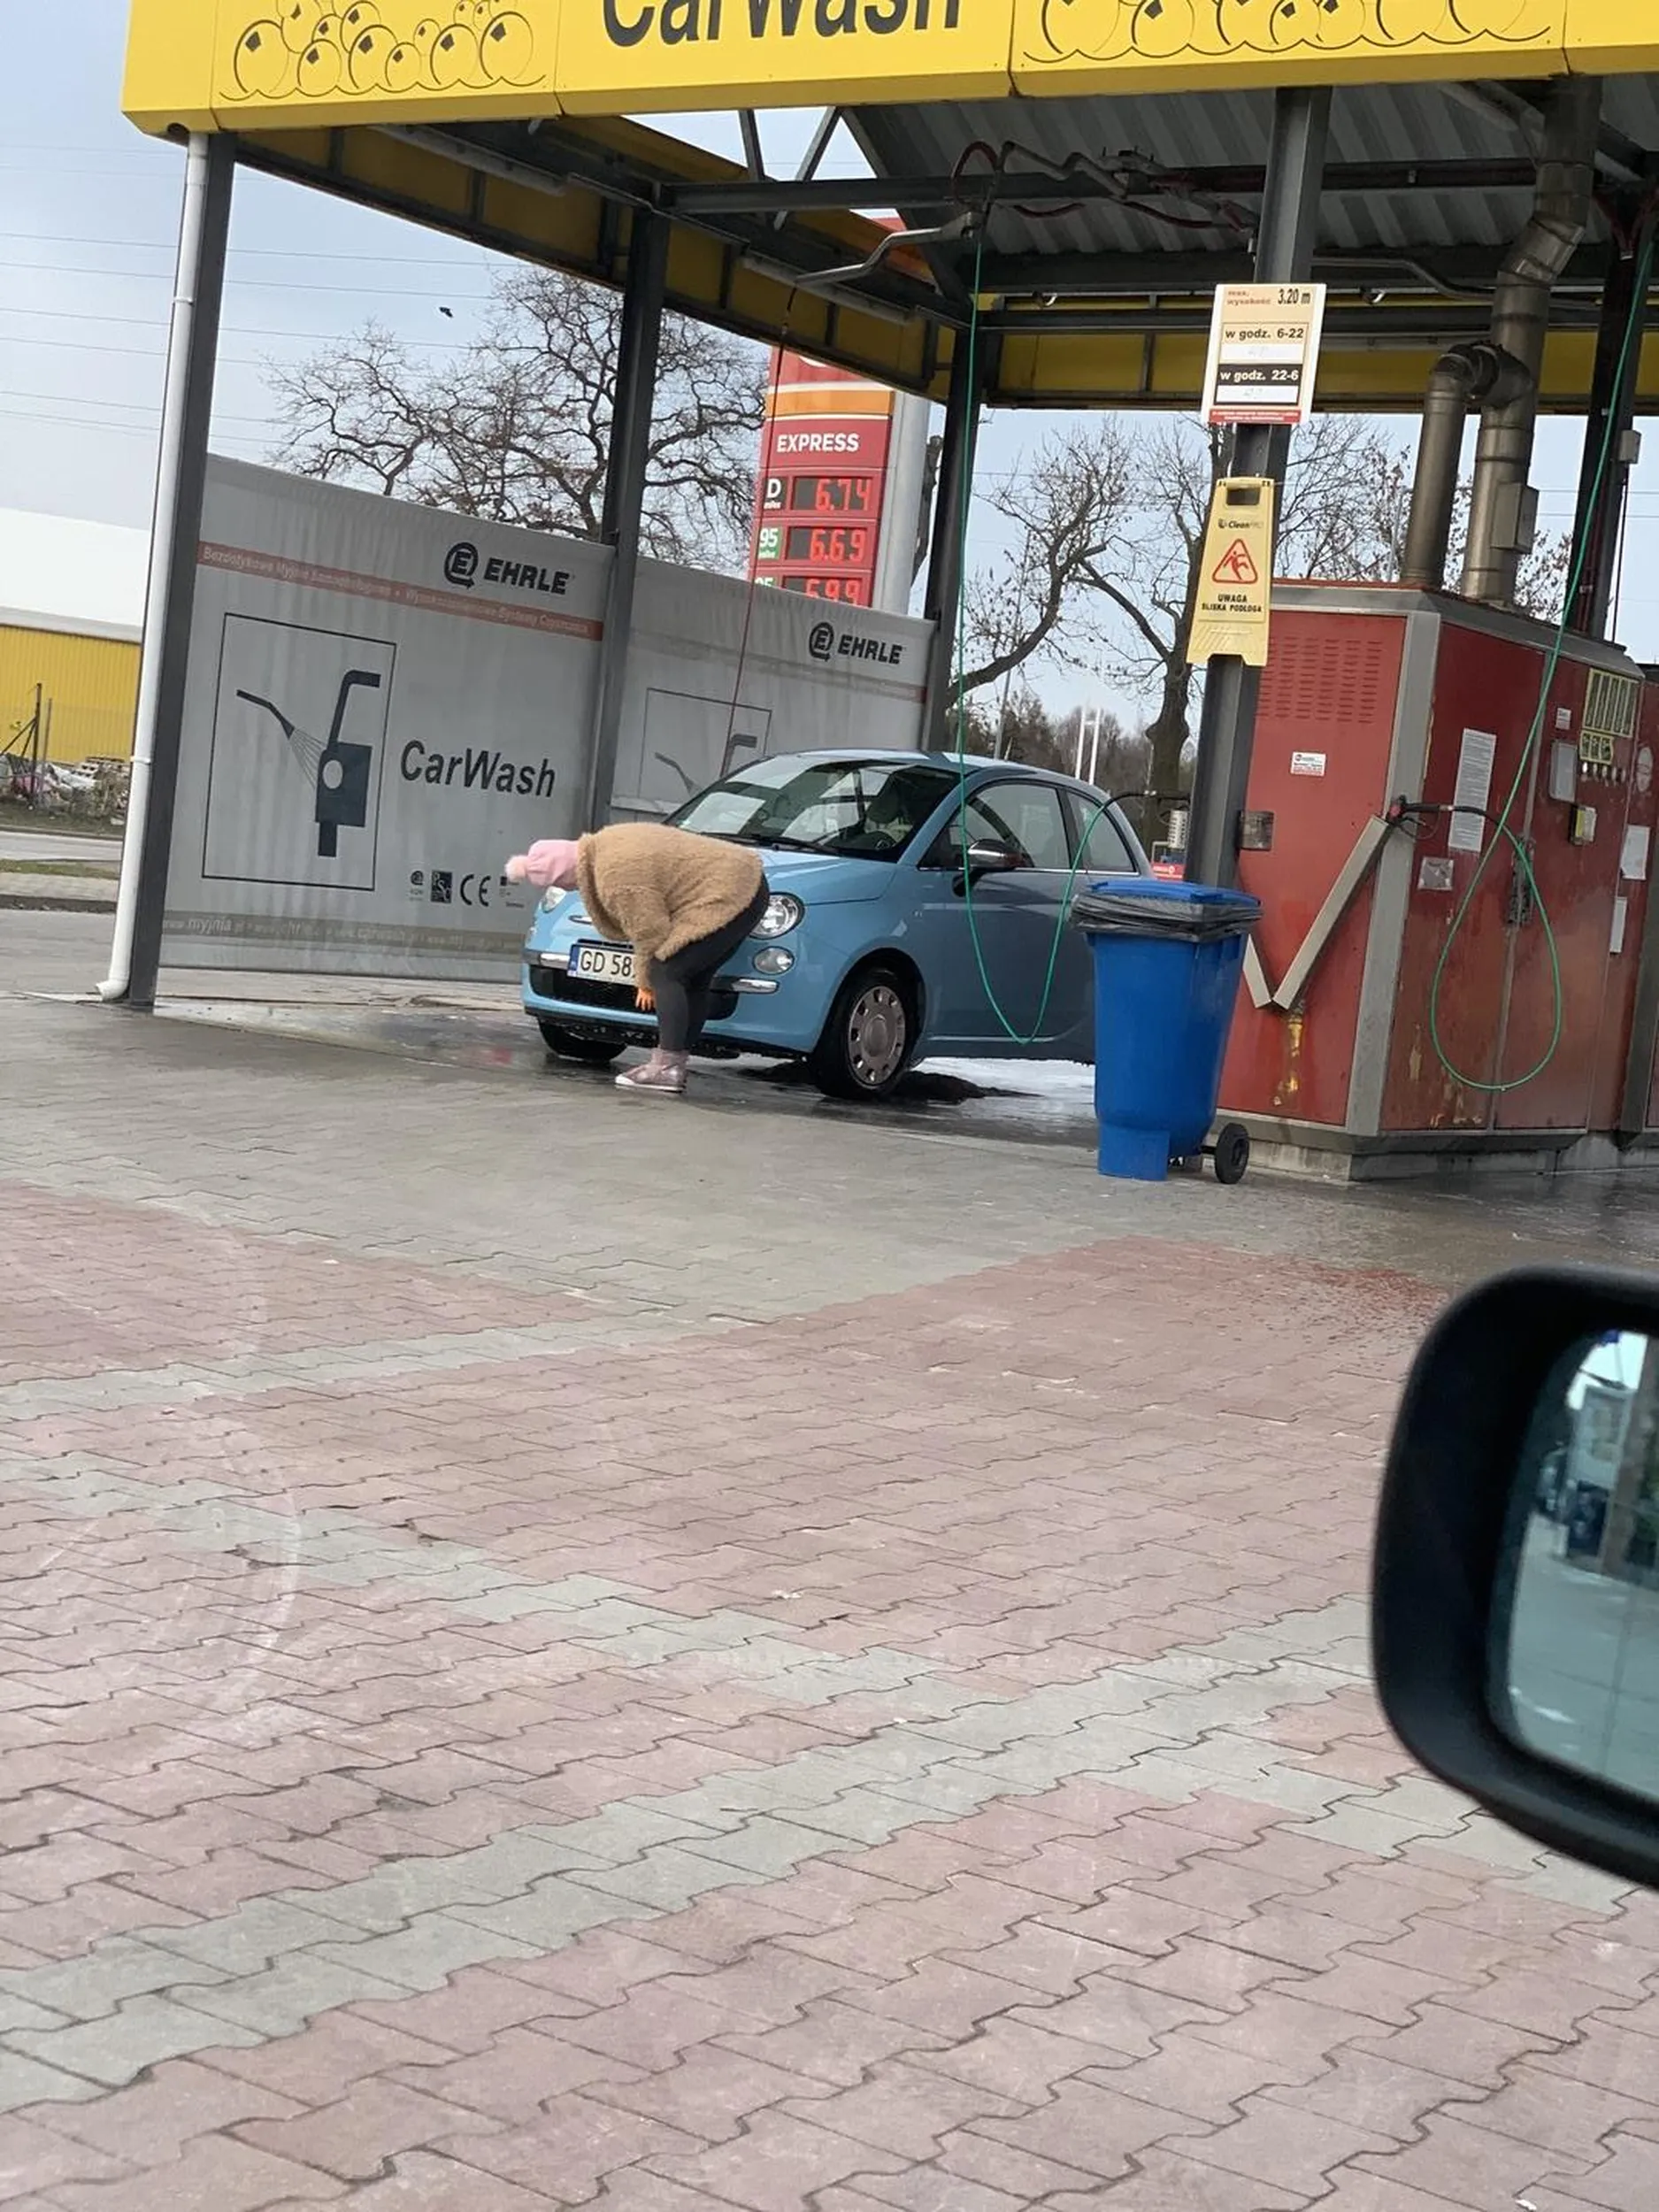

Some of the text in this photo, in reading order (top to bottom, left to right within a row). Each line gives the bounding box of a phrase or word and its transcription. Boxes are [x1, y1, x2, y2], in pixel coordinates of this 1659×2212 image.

[1278, 288, 1300, 304] 3.20
[1225, 328, 1304, 342] w godz. 6-22
[1220, 370, 1299, 383] w godz. 22-6
[777, 433, 860, 453] EXPRESS
[766, 479, 871, 511] D 6.74
[759, 527, 866, 563] 95 6.69
[483, 557, 572, 595] EHRLE
[1217, 594, 1247, 603] UWAGA
[837, 634, 903, 665] EHRLE
[400, 739, 557, 798] CarWash
[580, 950, 635, 979] GD 58
